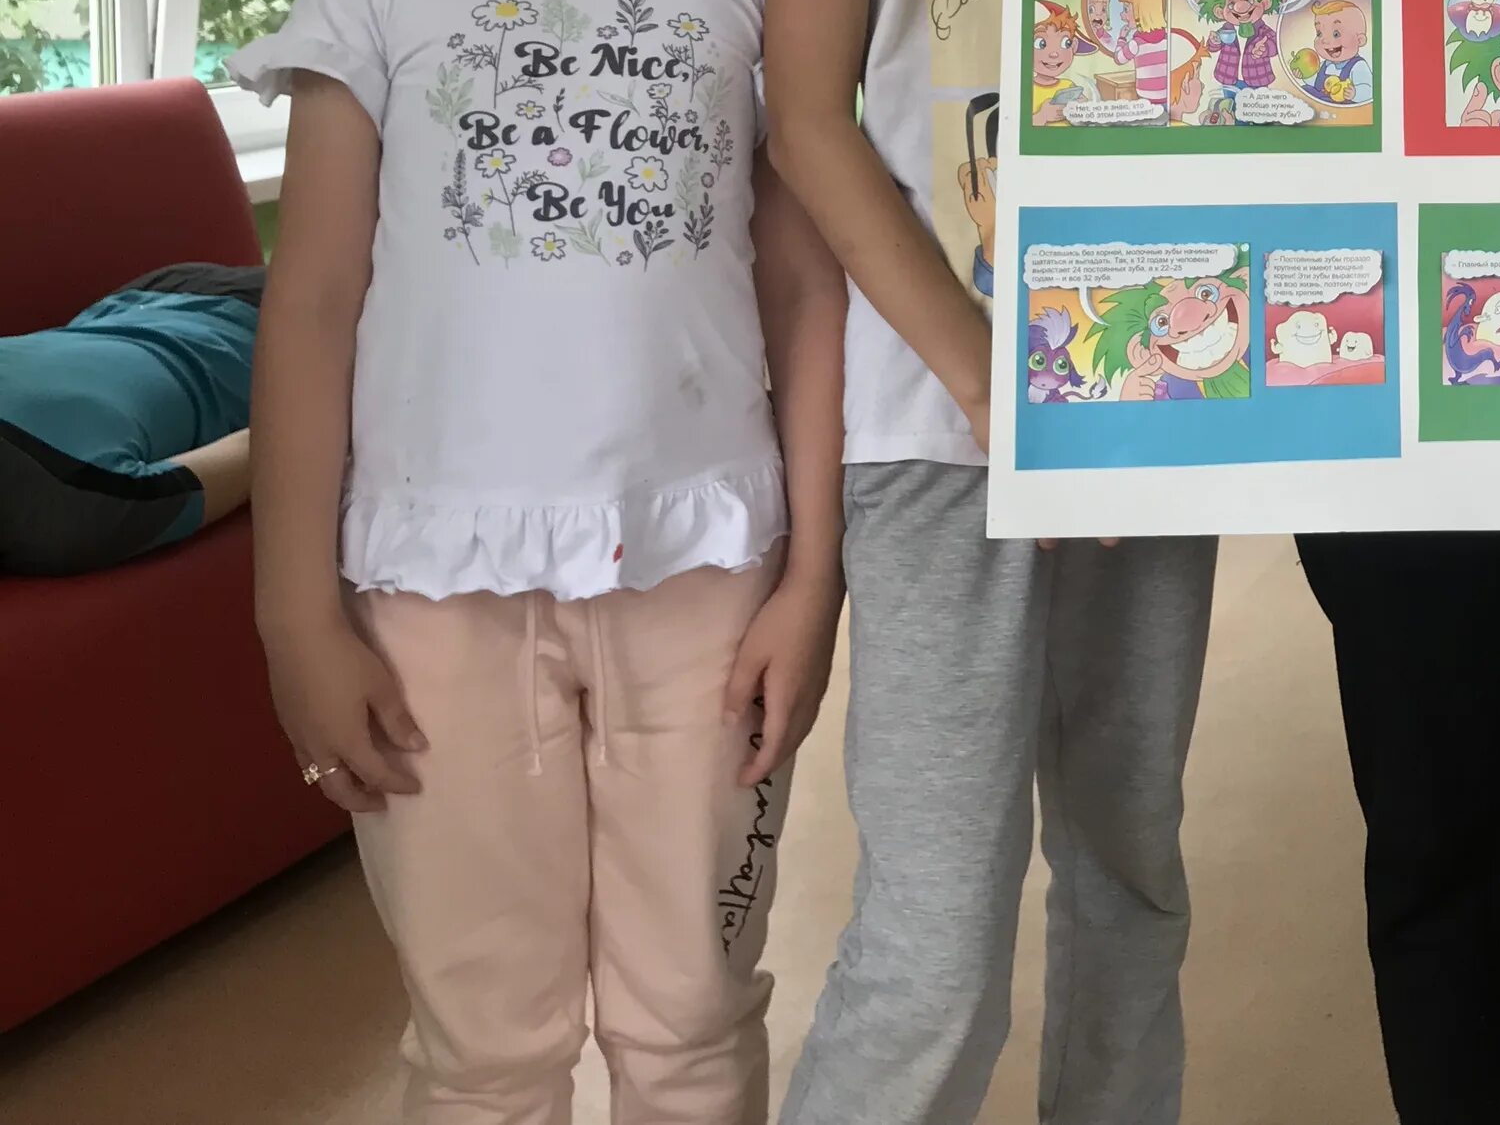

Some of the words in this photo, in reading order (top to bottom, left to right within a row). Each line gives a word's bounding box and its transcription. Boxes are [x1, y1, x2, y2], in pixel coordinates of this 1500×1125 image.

[514, 41, 581, 78] Be
[589, 43, 690, 82] Nice,
[459, 111, 520, 150] Be
[531, 126, 559, 146] a
[568, 109, 709, 155] Flower,
[526, 182, 589, 222] Be
[598, 181, 676, 227] You
[1136, 256, 1145, 264] 12
